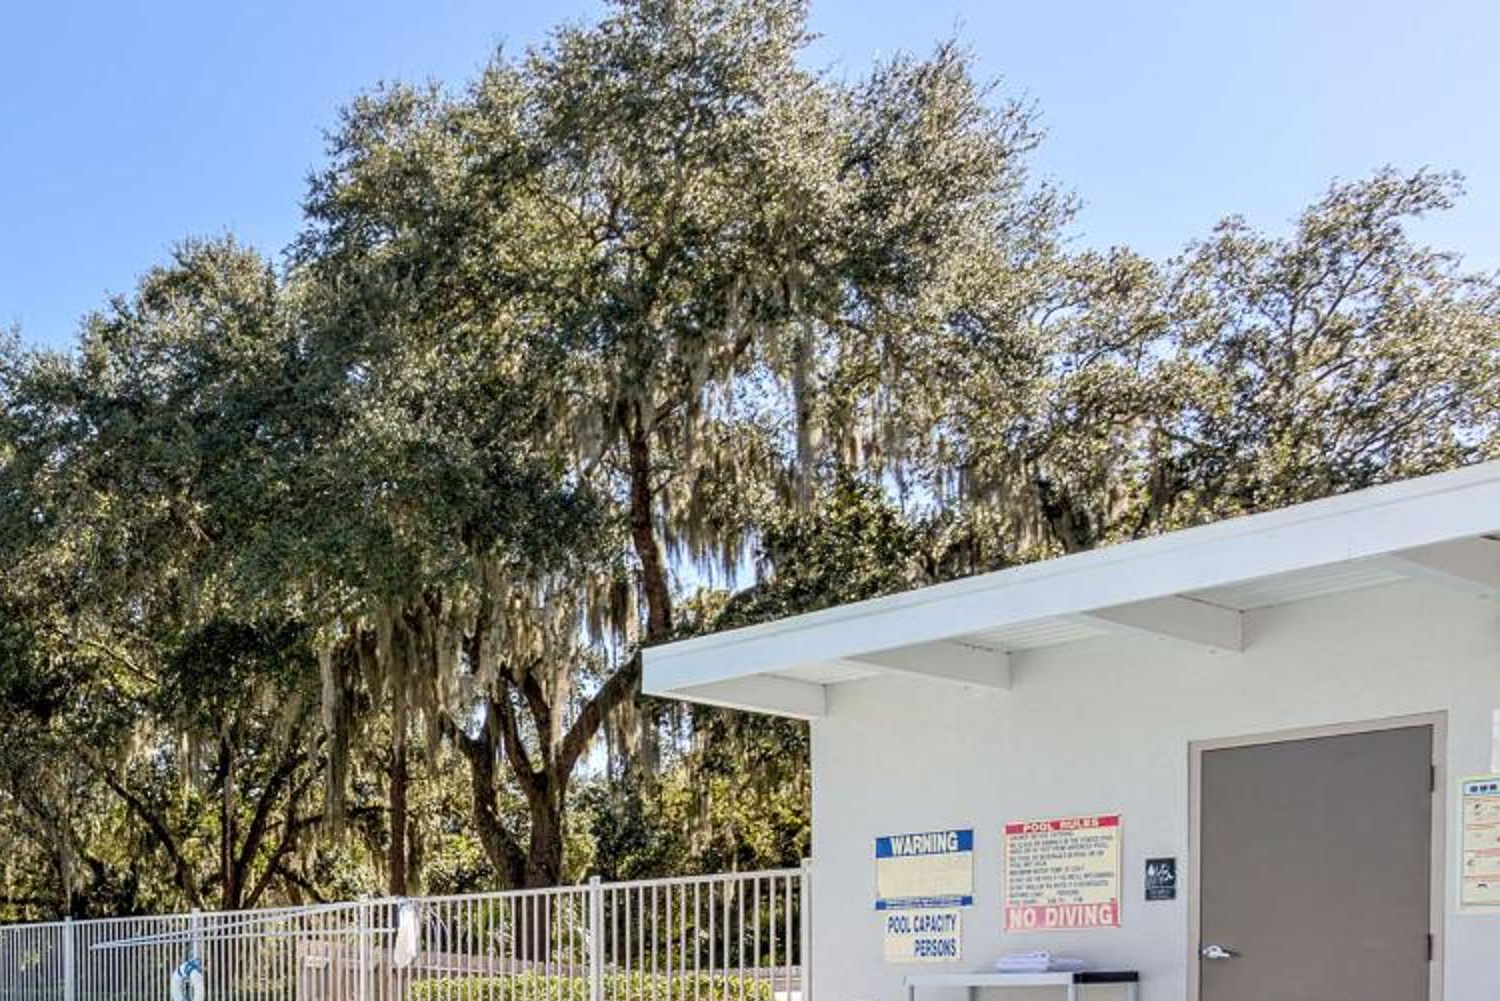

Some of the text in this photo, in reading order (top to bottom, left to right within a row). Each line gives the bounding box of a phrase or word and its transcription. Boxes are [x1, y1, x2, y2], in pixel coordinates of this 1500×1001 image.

[890, 831, 959, 856] WARNING
[887, 913, 957, 934] POOL CAPACITY
[1009, 902, 1113, 929] NO DIVING
[914, 938, 957, 957] PERSONS
